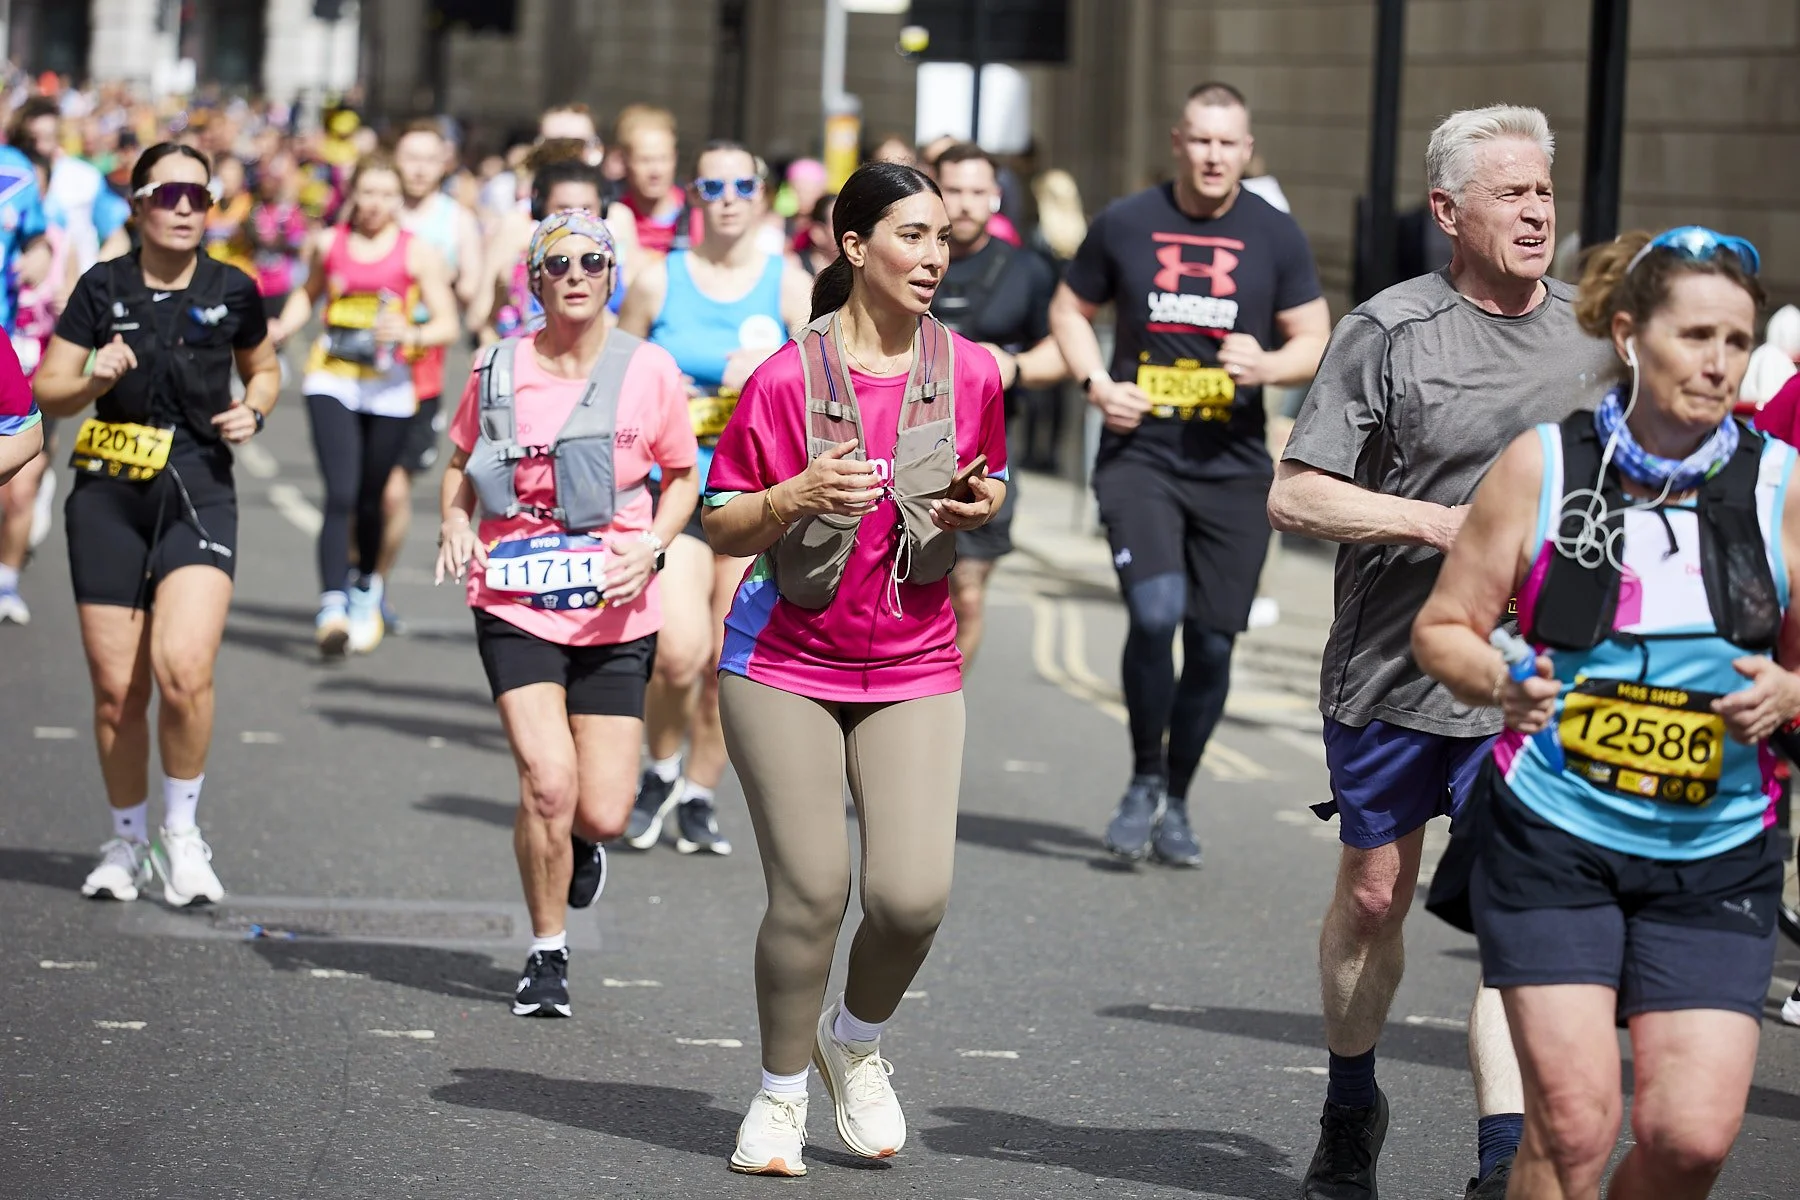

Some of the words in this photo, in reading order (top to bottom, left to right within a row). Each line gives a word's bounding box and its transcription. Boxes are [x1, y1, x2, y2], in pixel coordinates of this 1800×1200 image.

[87, 426, 163, 457] 12017
[498, 557, 592, 585] 11711
[1617, 682, 1649, 702] MRS
[1650, 689, 1689, 707] SHEP
[1577, 708, 1714, 764] 12586
